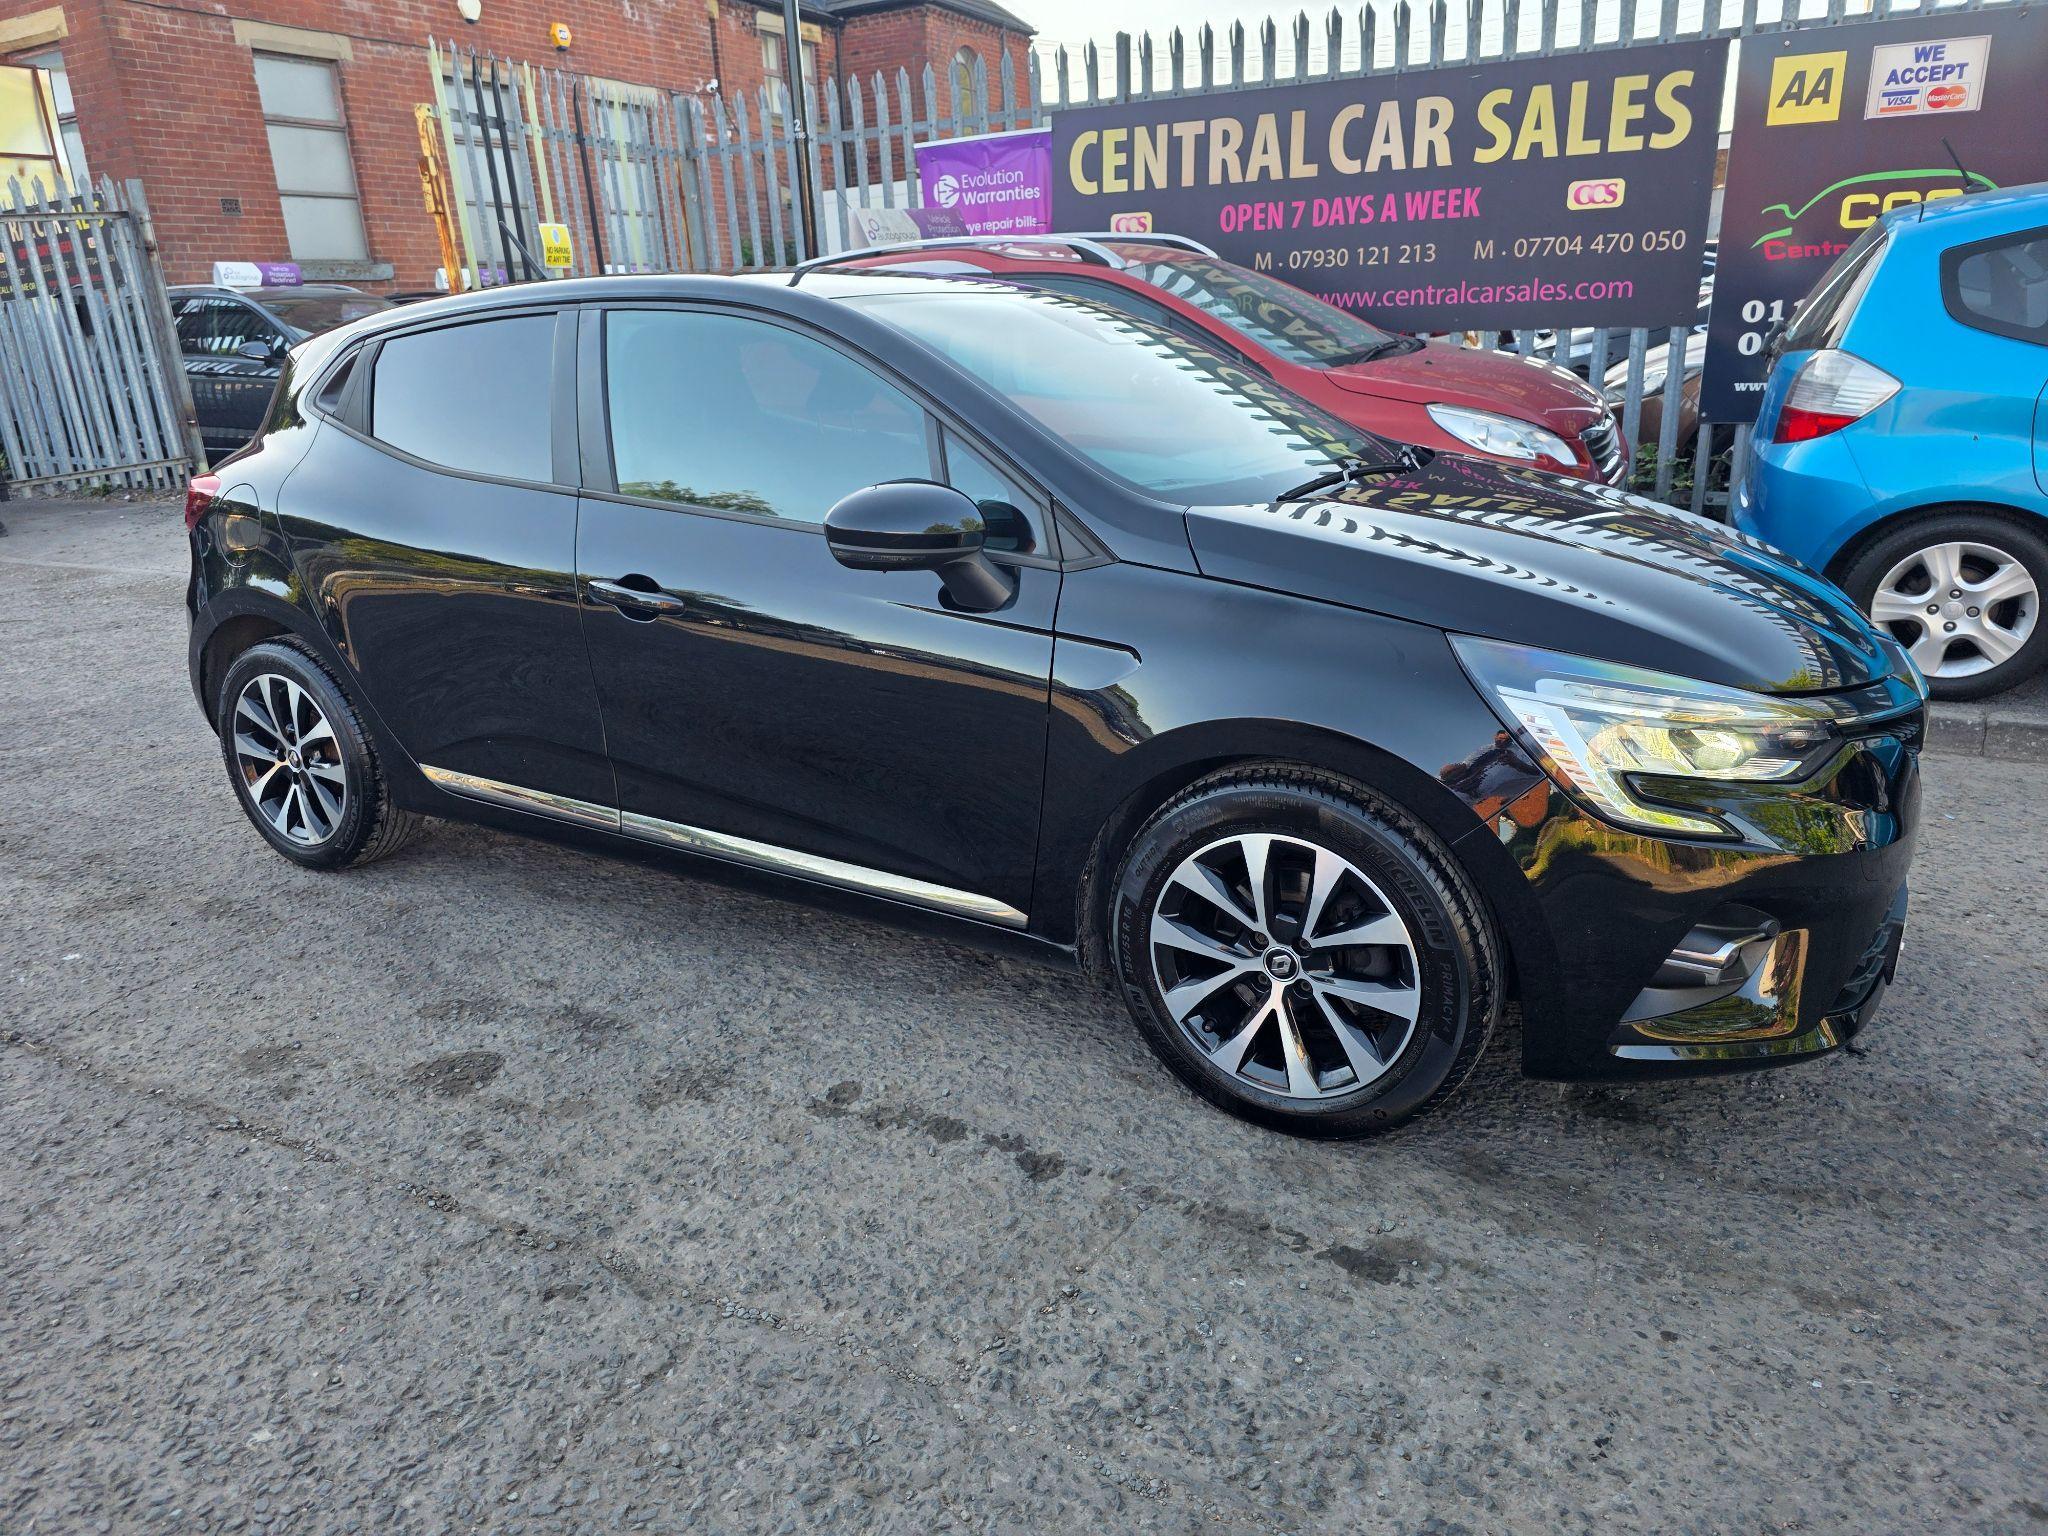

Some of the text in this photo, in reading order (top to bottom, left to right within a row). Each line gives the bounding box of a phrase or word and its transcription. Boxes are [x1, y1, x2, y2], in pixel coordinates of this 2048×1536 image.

[1914, 44, 1947, 63] WE
[1885, 62, 1970, 86] ACCEPT
[1777, 67, 1835, 108] AA
[1927, 94, 1967, 102] MasterCard
[1887, 96, 1913, 106] VISA
[1069, 70, 1696, 196] CENTRAL CAR SALES
[962, 168, 1024, 189] Evolution
[962, 185, 1041, 206] Warranties
[1573, 182, 1620, 206] CCS
[1219, 186, 1482, 233] OPEN 7 DAYS A WEEK
[982, 218, 1013, 234] repair
[1115, 214, 1148, 233] CCS
[1254, 251, 1272, 271] M
[1288, 248, 1349, 270] 07930
[1357, 246, 1390, 265] 121
[1398, 243, 1437, 264] 213
[1473, 239, 1495, 260] M
[1513, 234, 1583, 259] 07704
[1590, 231, 1635, 256] 470
[1641, 228, 1687, 252] 050
[1763, 240, 1849, 262] Centr
[1315, 278, 1634, 310] www.centralcarsales.com
[1135, 845, 1160, 878] OUTSIDE
[1363, 841, 1448, 946] MICHELIN
[1122, 933, 1134, 975] 195/55
[1439, 961, 1456, 1026] PRIMACY
